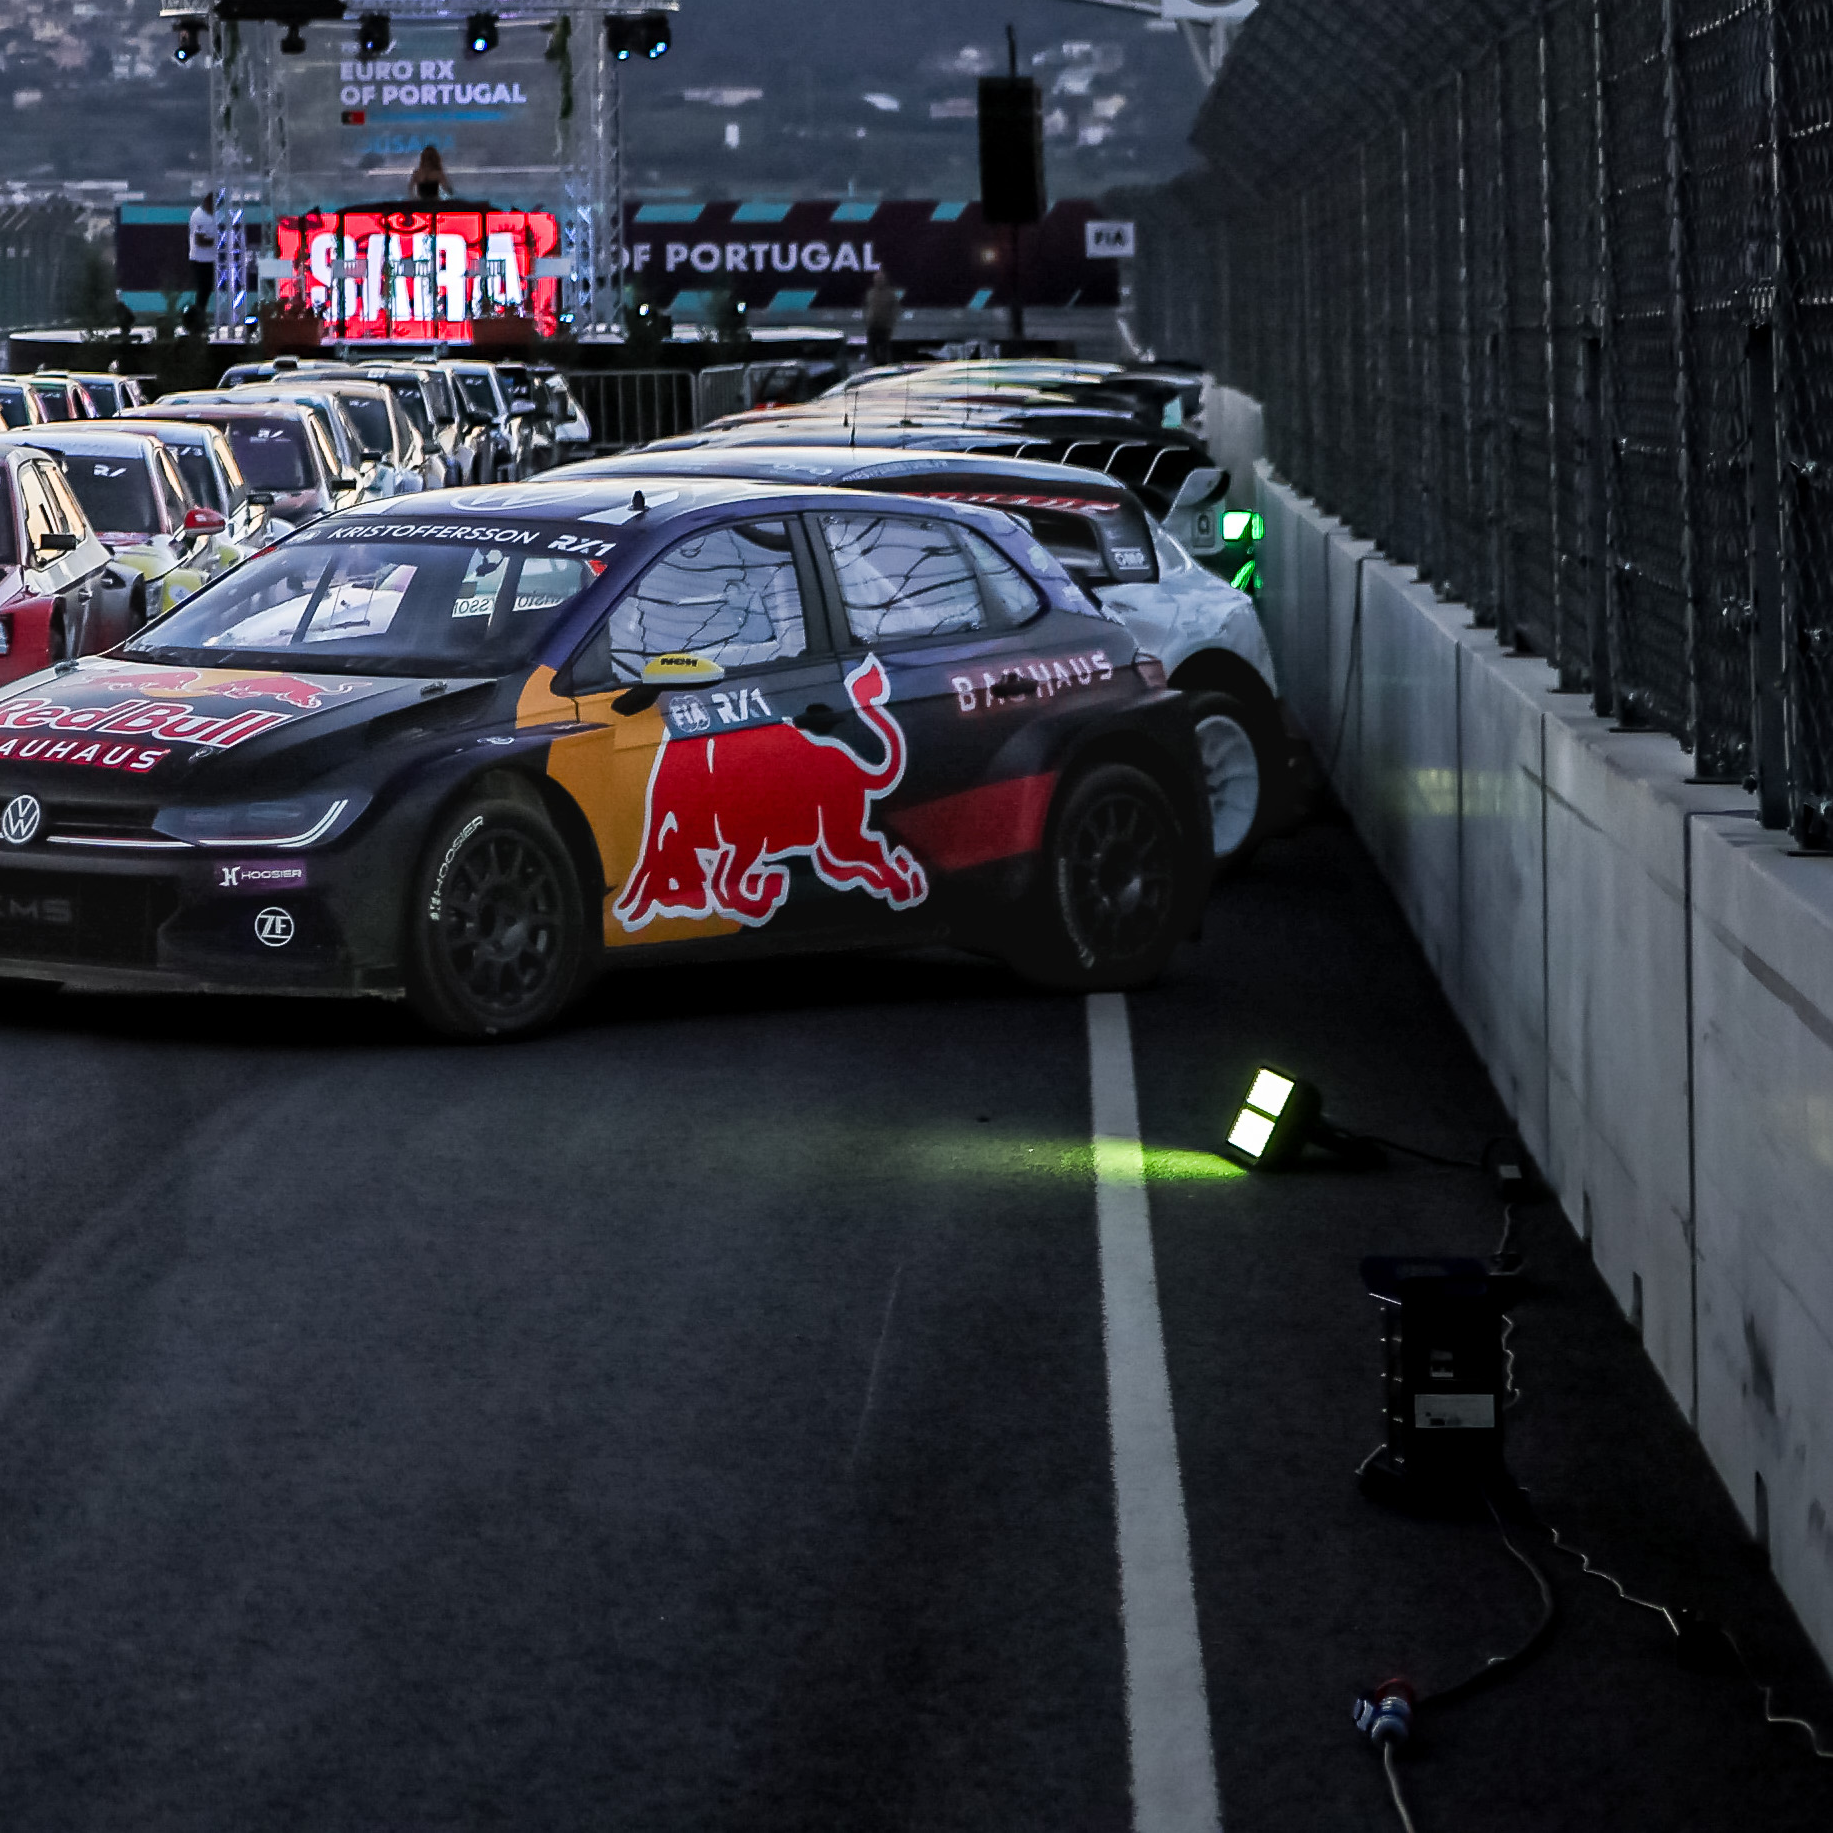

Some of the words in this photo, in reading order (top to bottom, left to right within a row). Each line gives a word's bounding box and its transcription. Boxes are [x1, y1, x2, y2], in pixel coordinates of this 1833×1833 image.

[340, 60, 414, 81] EURO
[420, 60, 455, 81] RX
[340, 85, 378, 106] OF
[383, 83, 528, 105] PORTUGAL
[665, 241, 881, 273] PORTUGAL
[327, 523, 540, 545] KRISTOFFERSSON
[241, 868, 302, 881] HOOSIER
